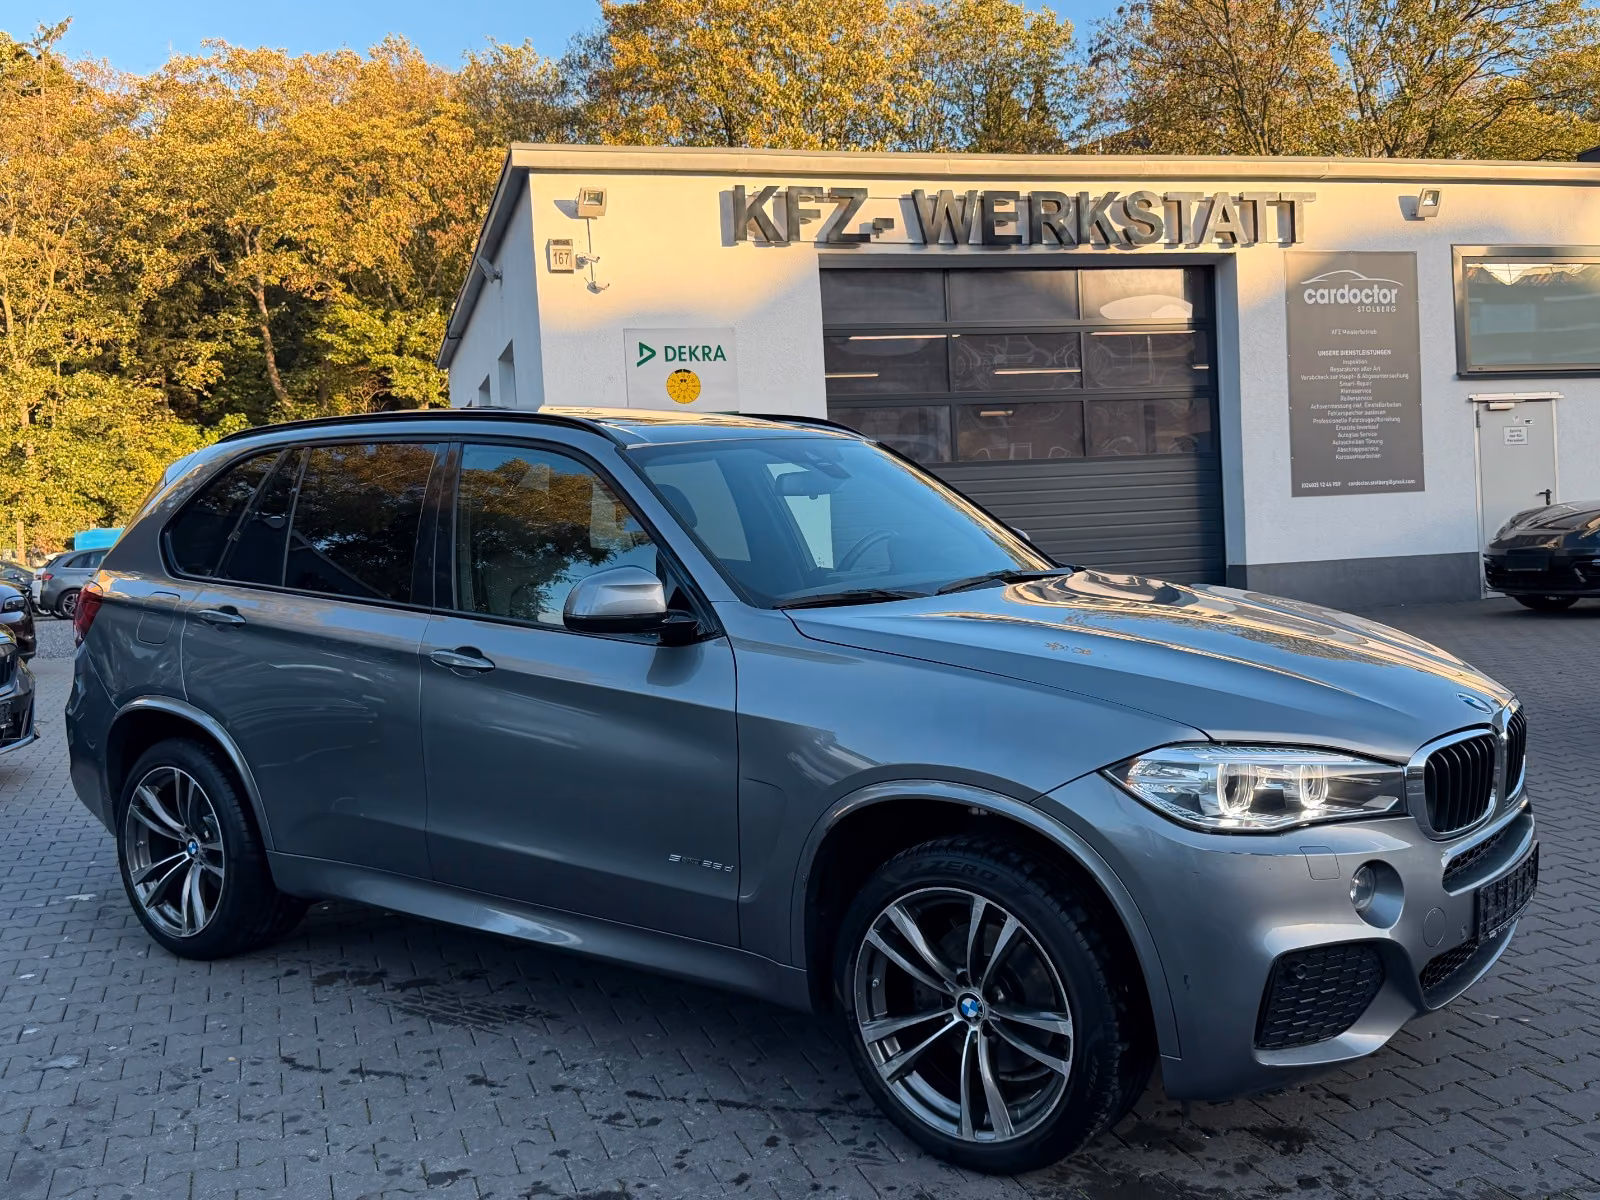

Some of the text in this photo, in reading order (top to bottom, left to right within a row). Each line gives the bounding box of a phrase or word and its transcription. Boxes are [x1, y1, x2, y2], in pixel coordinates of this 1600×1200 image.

[553, 252, 570, 265] 167
[1303, 284, 1398, 305] cardoctor
[1357, 305, 1397, 313] STOLBERG
[664, 345, 727, 362] DEKRA
